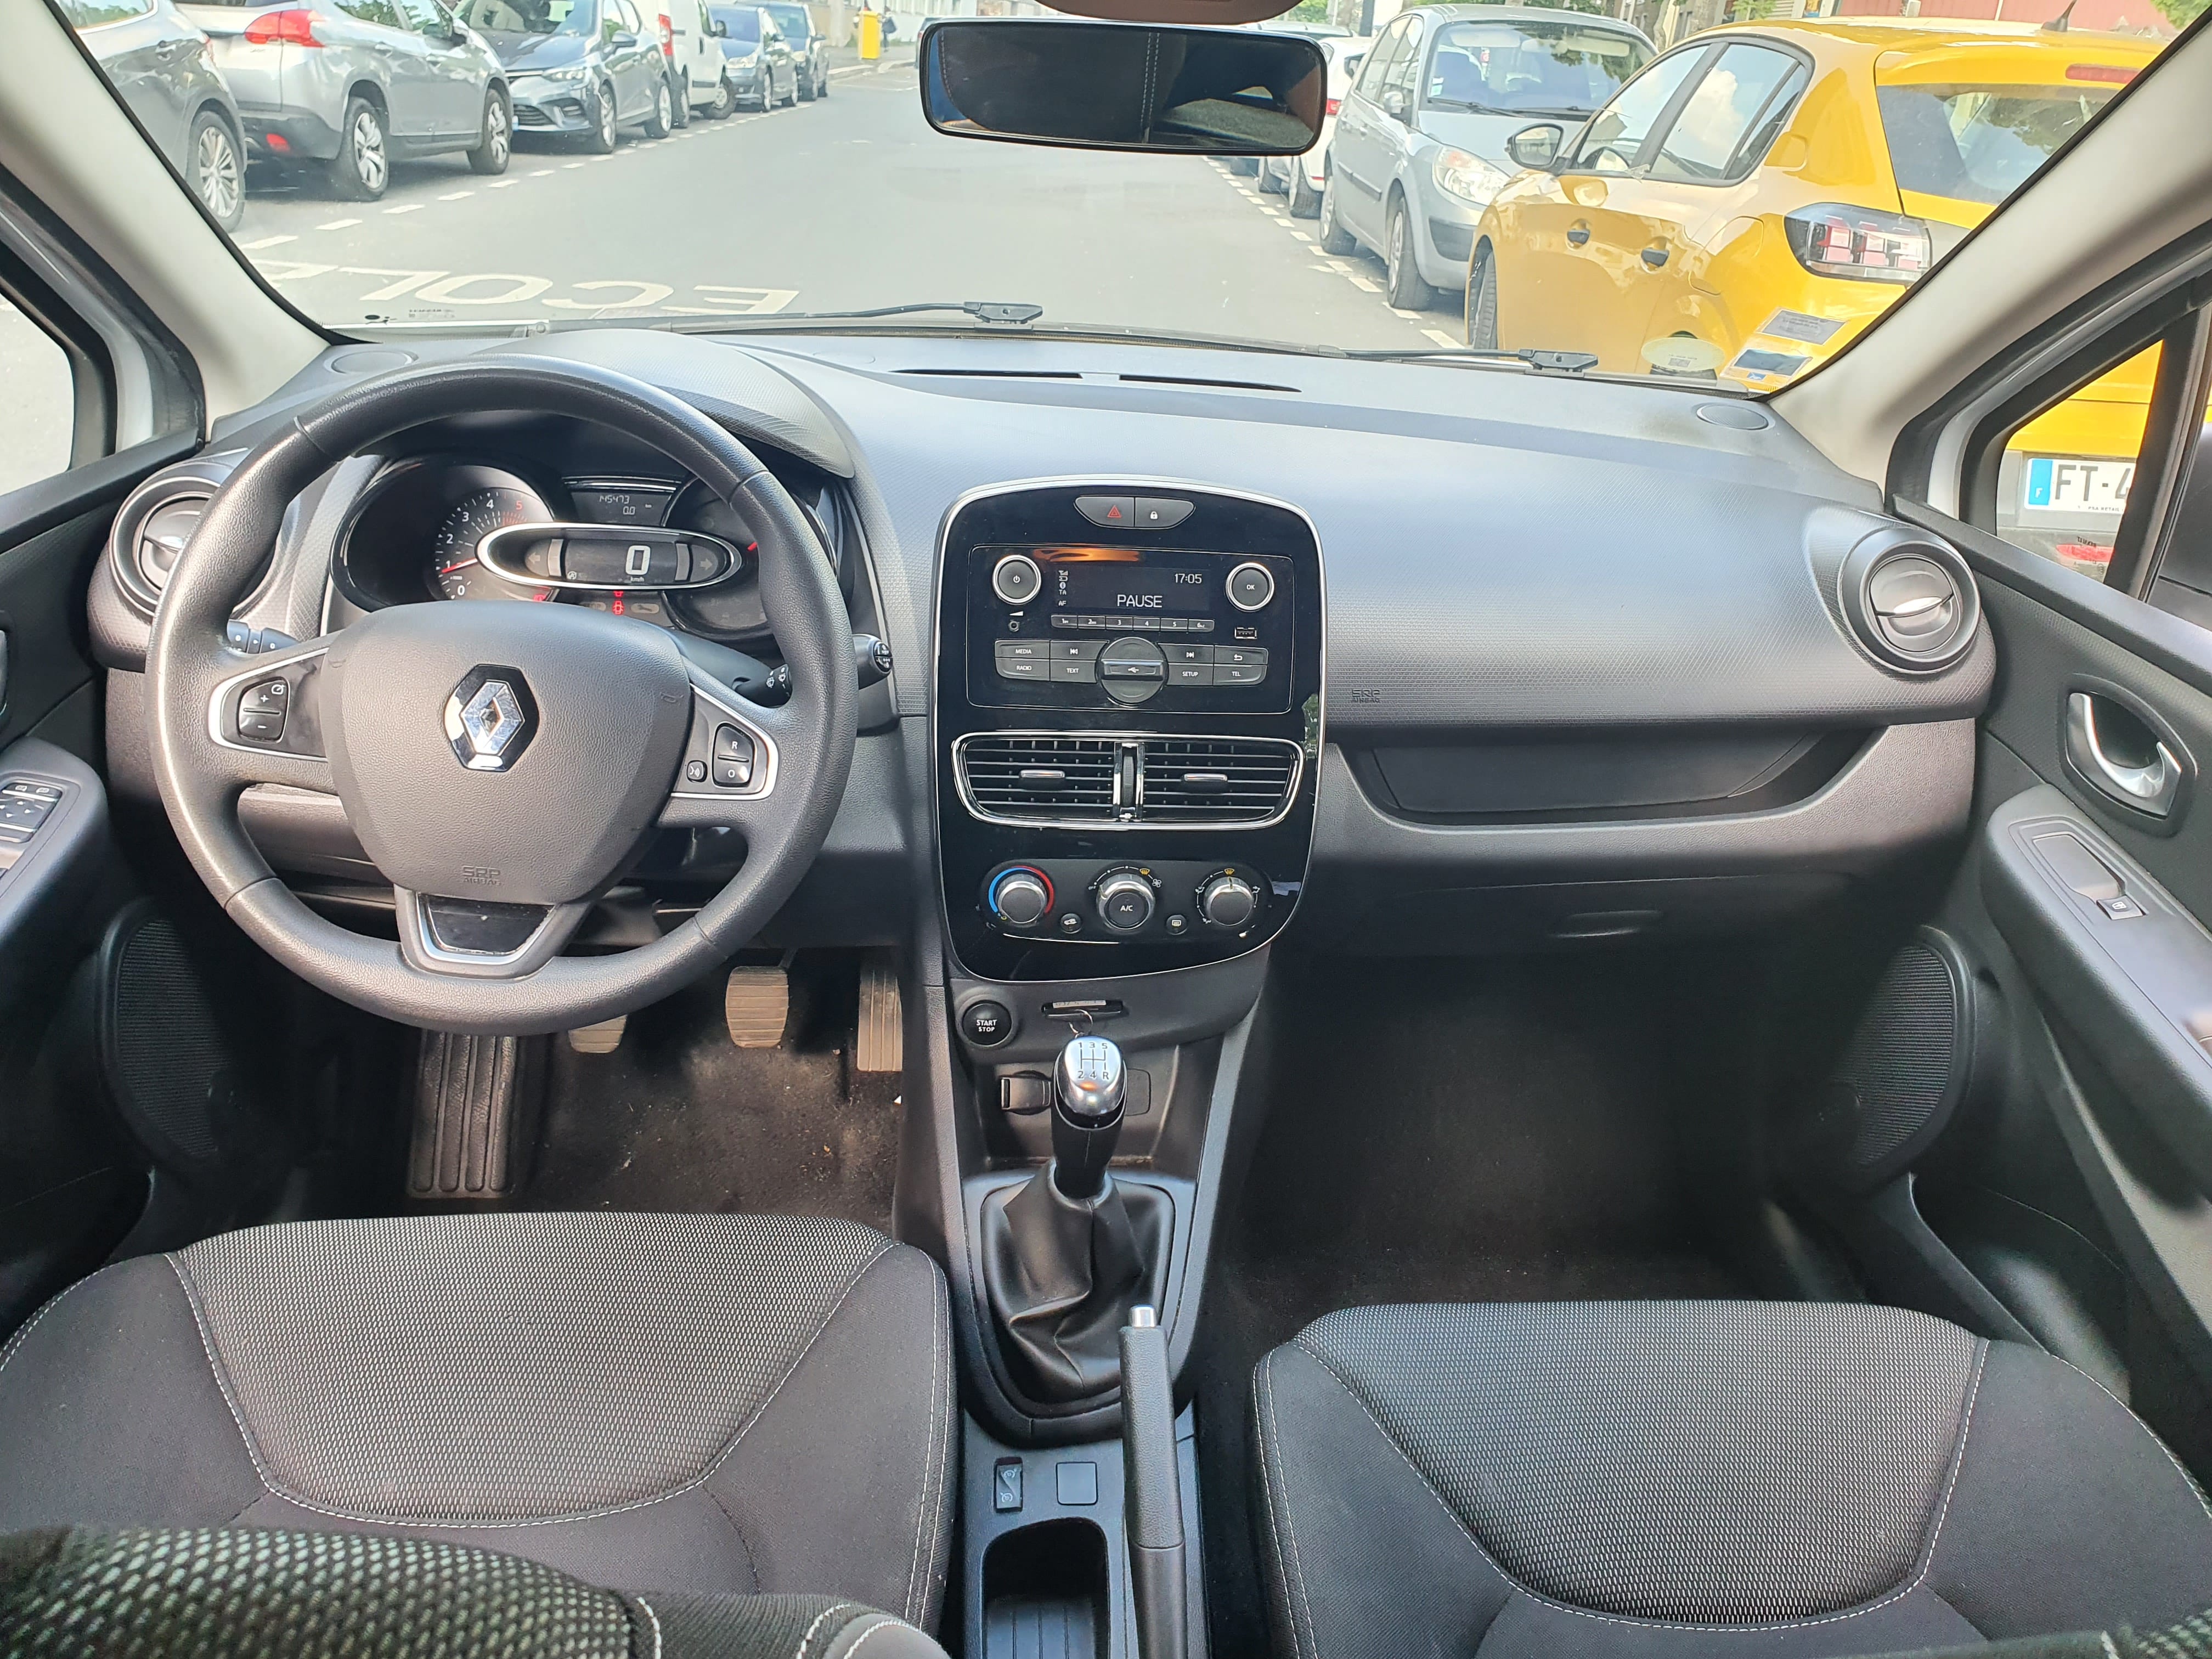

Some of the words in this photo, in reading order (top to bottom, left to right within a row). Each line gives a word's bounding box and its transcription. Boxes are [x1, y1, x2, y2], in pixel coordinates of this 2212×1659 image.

[486, 499, 494, 509] 4
[516, 500, 523, 510] 5
[462, 511, 470, 522] 3
[446, 534, 454, 544] 2
[445, 560, 451, 569] 1
[625, 545, 651, 575] 0
[1174, 573, 1203, 584] 17:05
[457, 585, 465, 596] 0
[1117, 594, 1163, 608] PAUSE
[1352, 689, 1380, 697] SRP
[731, 741, 738, 749] R
[461, 865, 501, 878] SRP
[464, 877, 501, 886] AIRBAG
[1077, 1070, 1084, 1079] 2
[1090, 1070, 1097, 1079] 4
[1103, 1071, 1109, 1080] R
